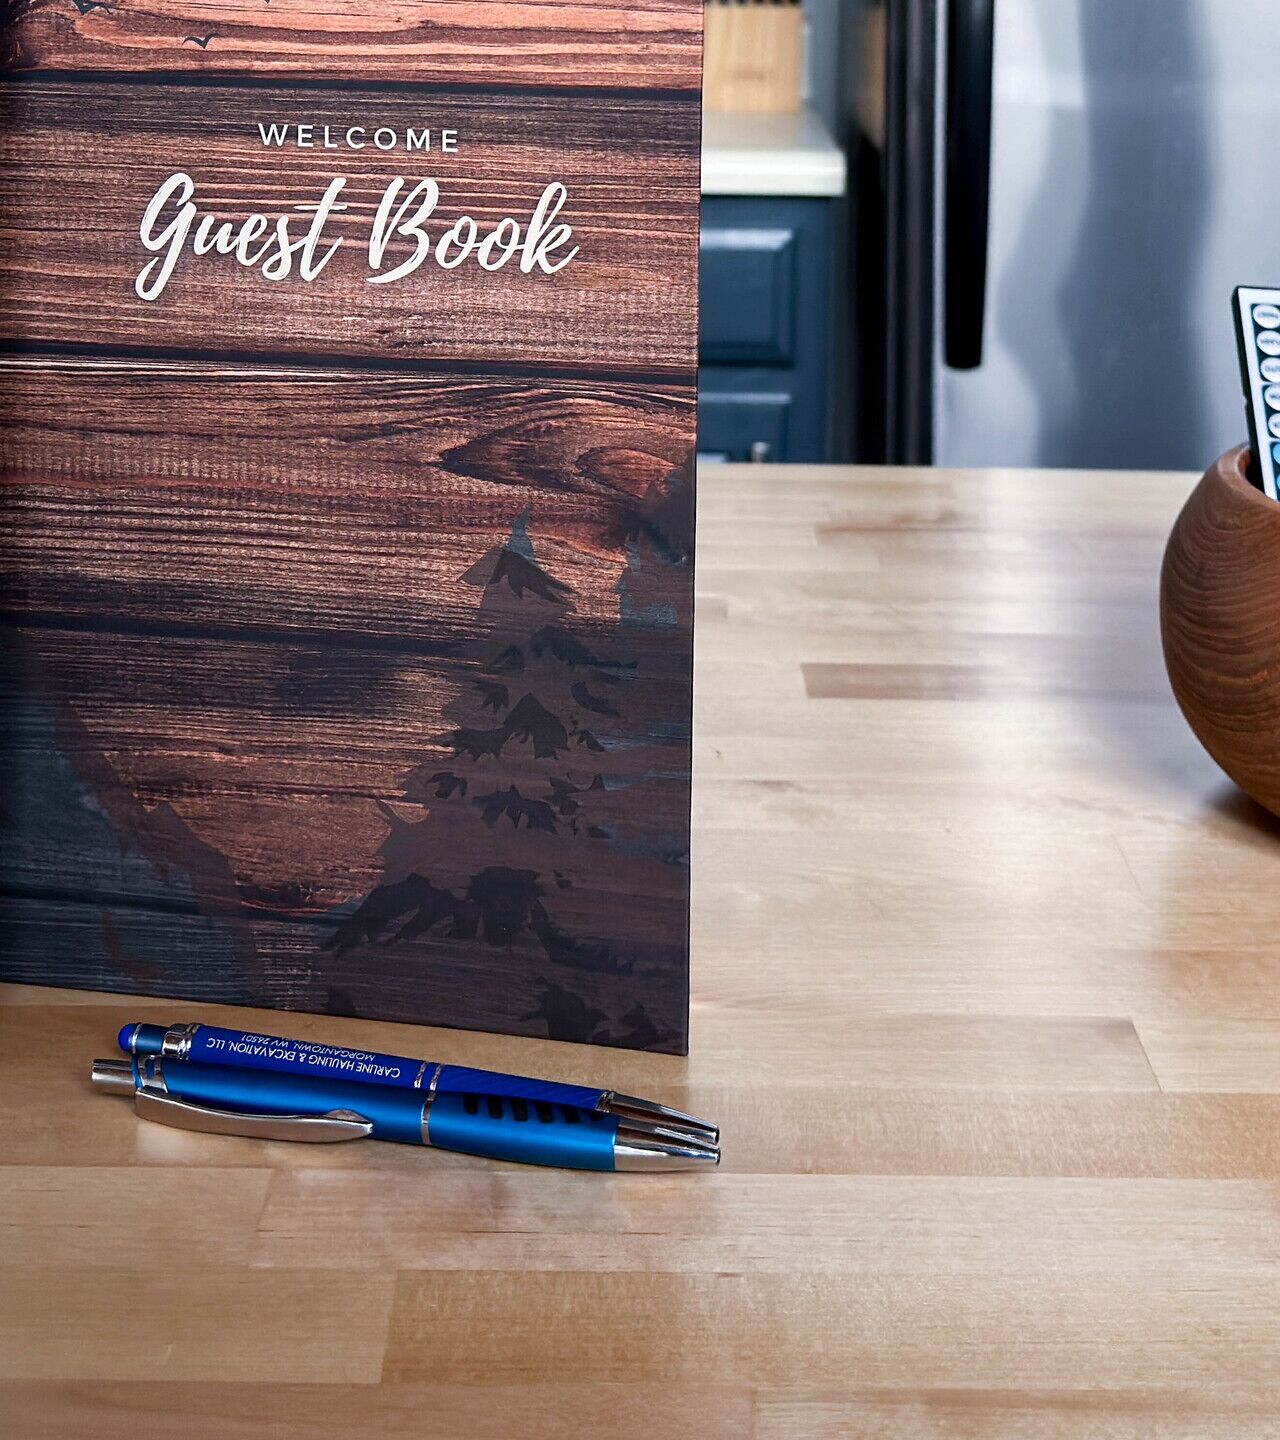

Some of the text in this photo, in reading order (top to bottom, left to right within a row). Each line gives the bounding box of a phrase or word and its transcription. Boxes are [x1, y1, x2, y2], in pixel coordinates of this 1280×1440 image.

[257, 123, 459, 153] WELCOME
[134, 172, 580, 301] Guest Book
[241, 1034, 271, 1046] 26501
[271, 1039, 289, 1048] WV
[206, 1037, 401, 1078] CARLINE HAULING & EXCAVATION, LLC
